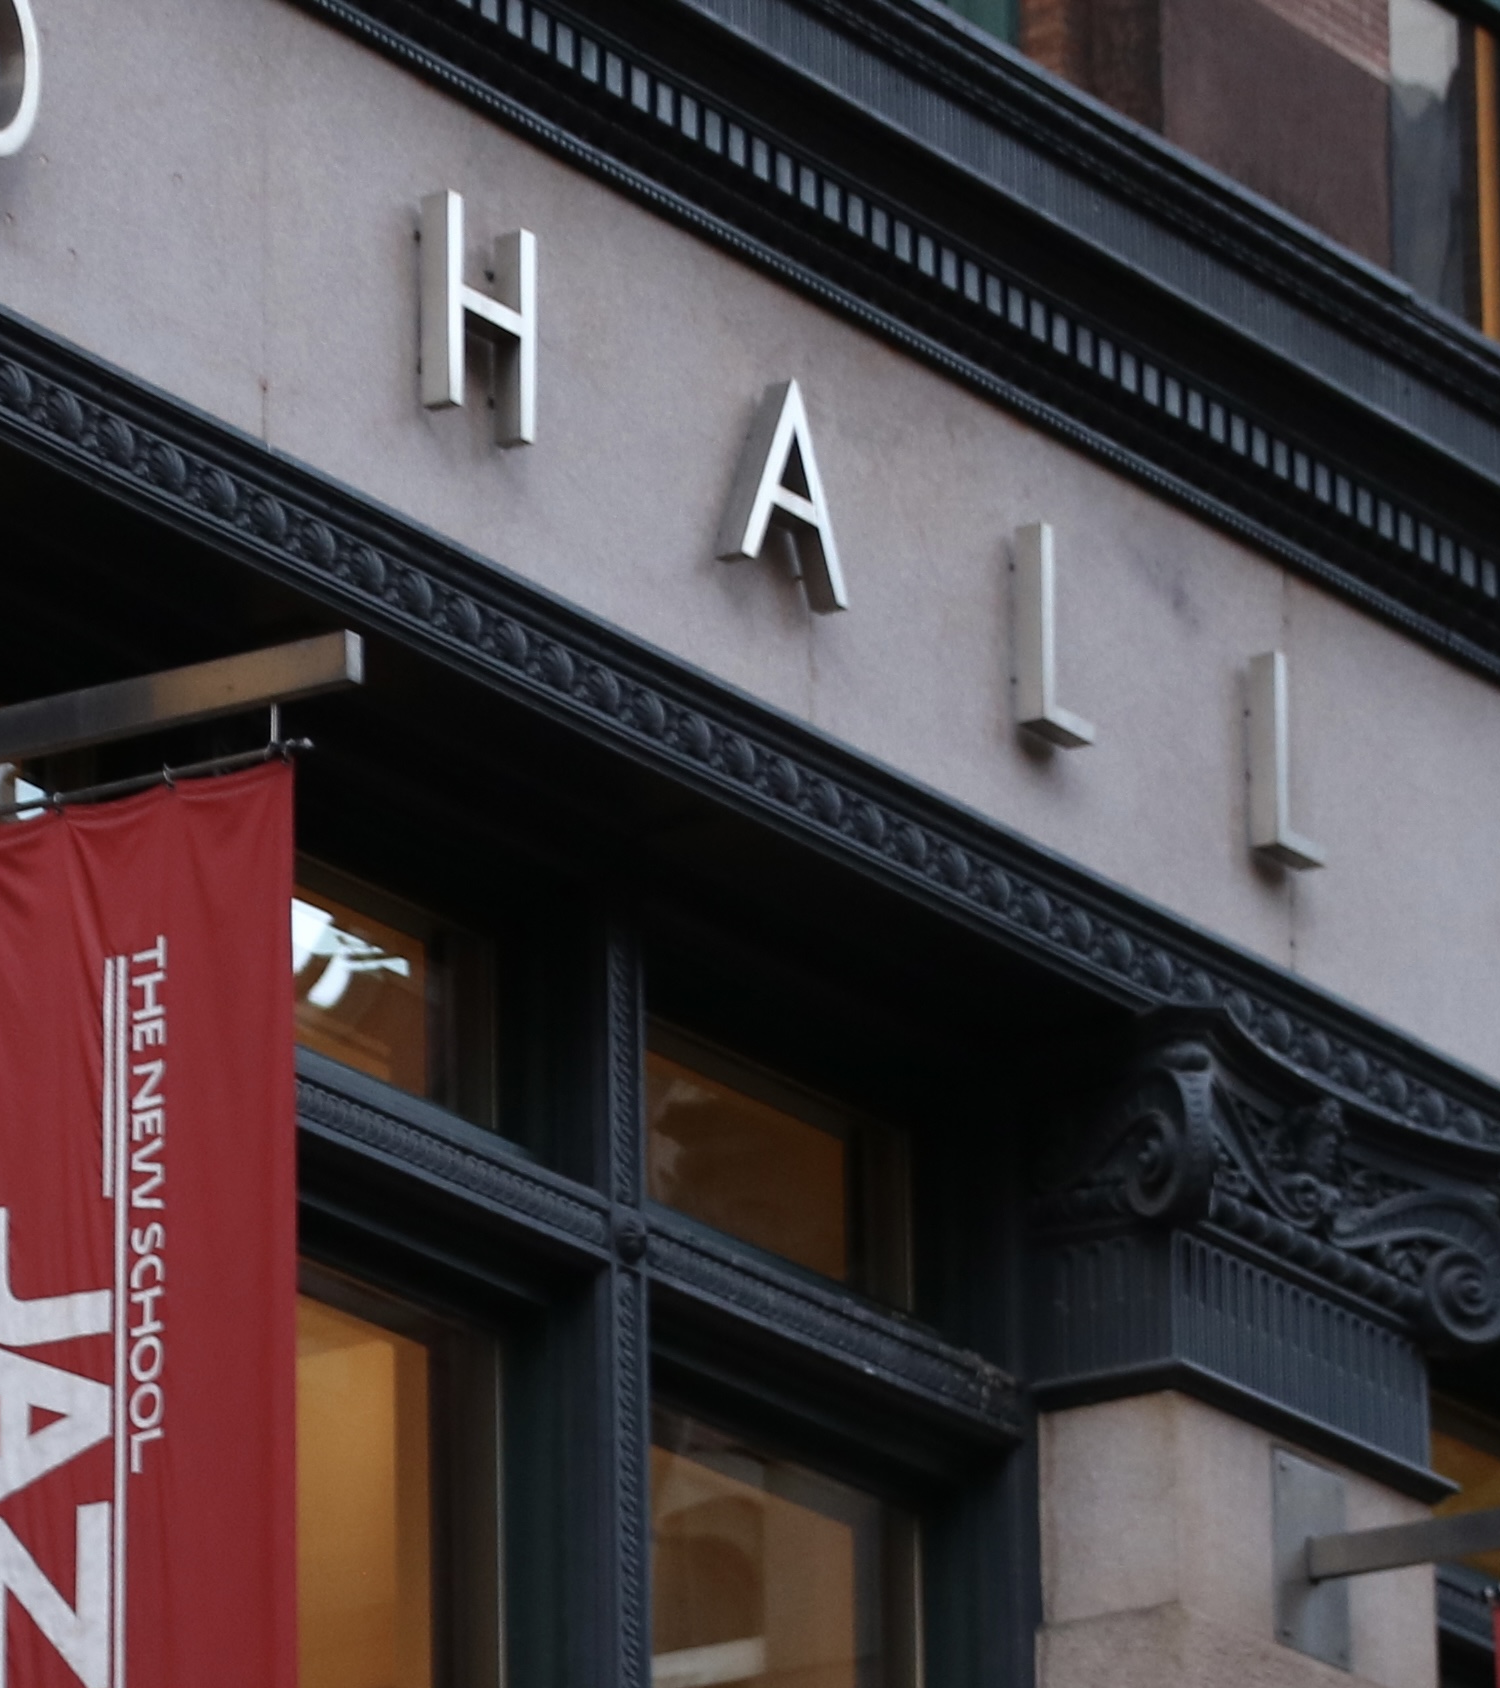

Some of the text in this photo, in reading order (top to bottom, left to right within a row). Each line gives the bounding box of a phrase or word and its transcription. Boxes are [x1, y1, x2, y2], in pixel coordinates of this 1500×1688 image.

[415, 188, 1326, 874] HALL
[129, 934, 167, 1474] THE NEW SCHOOL
